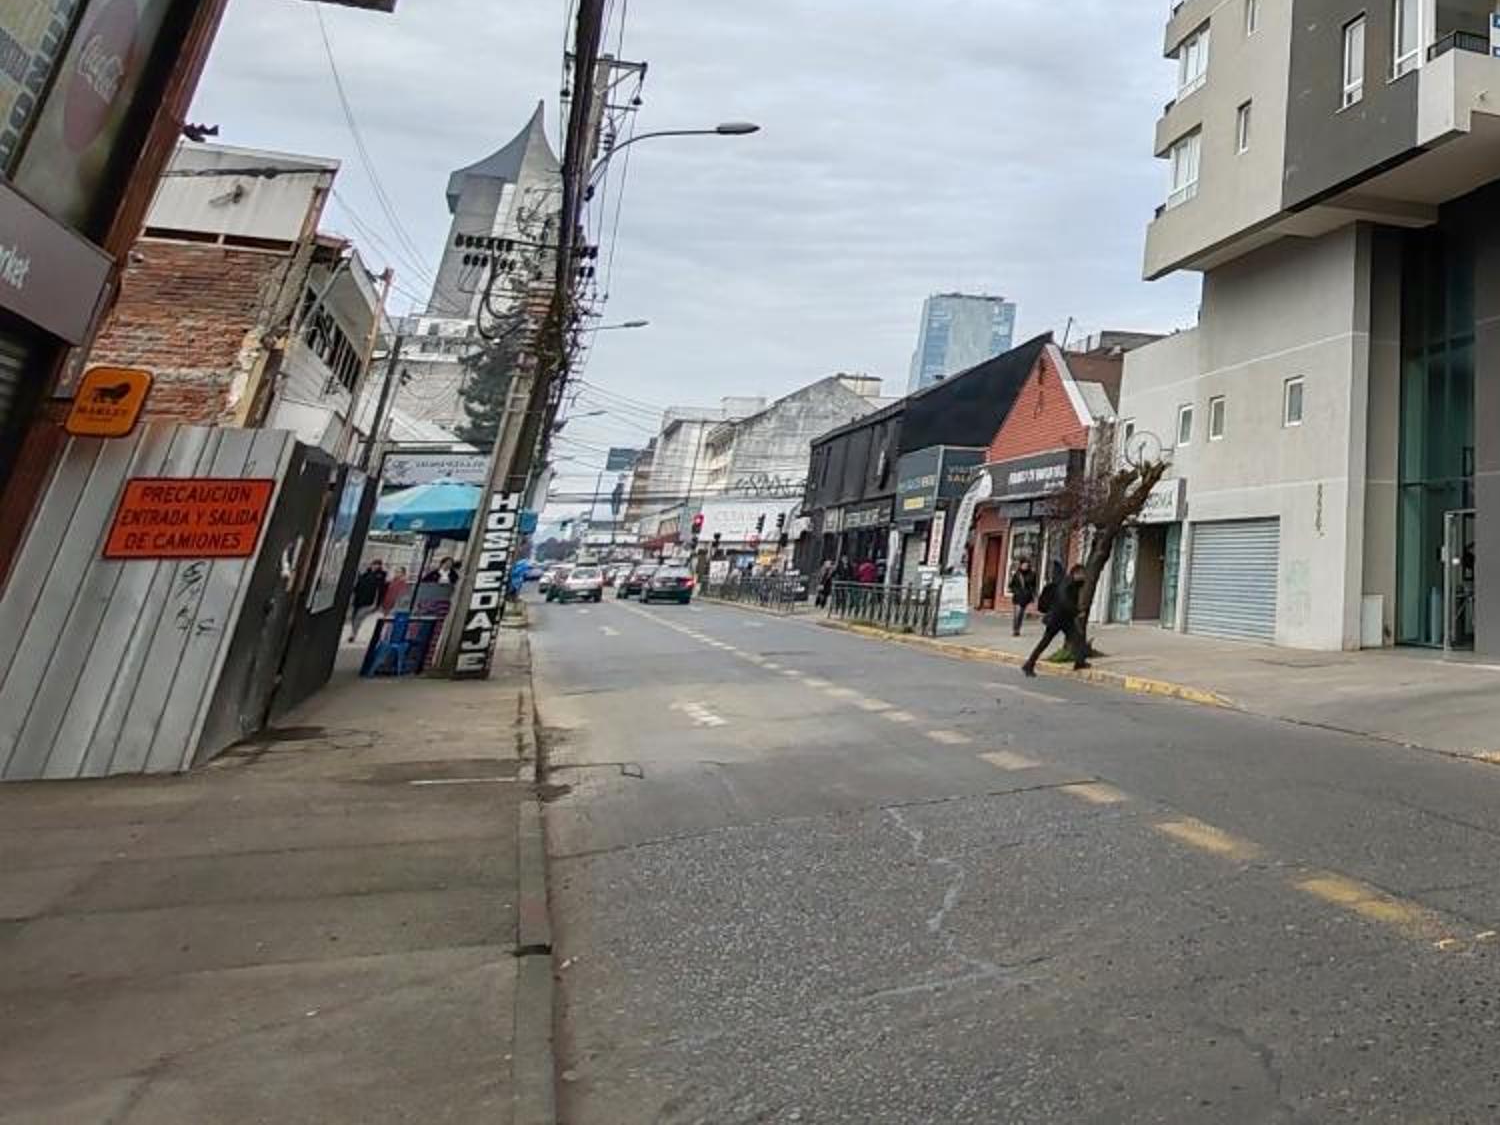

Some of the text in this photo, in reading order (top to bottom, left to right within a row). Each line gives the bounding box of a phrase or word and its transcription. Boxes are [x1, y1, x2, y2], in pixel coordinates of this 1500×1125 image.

[120, 508, 260, 526] ENTRADA Y SALIDA
[124, 532, 242, 550] DE CAMIONES
[454, 491, 521, 673] HOSPEDAJE
